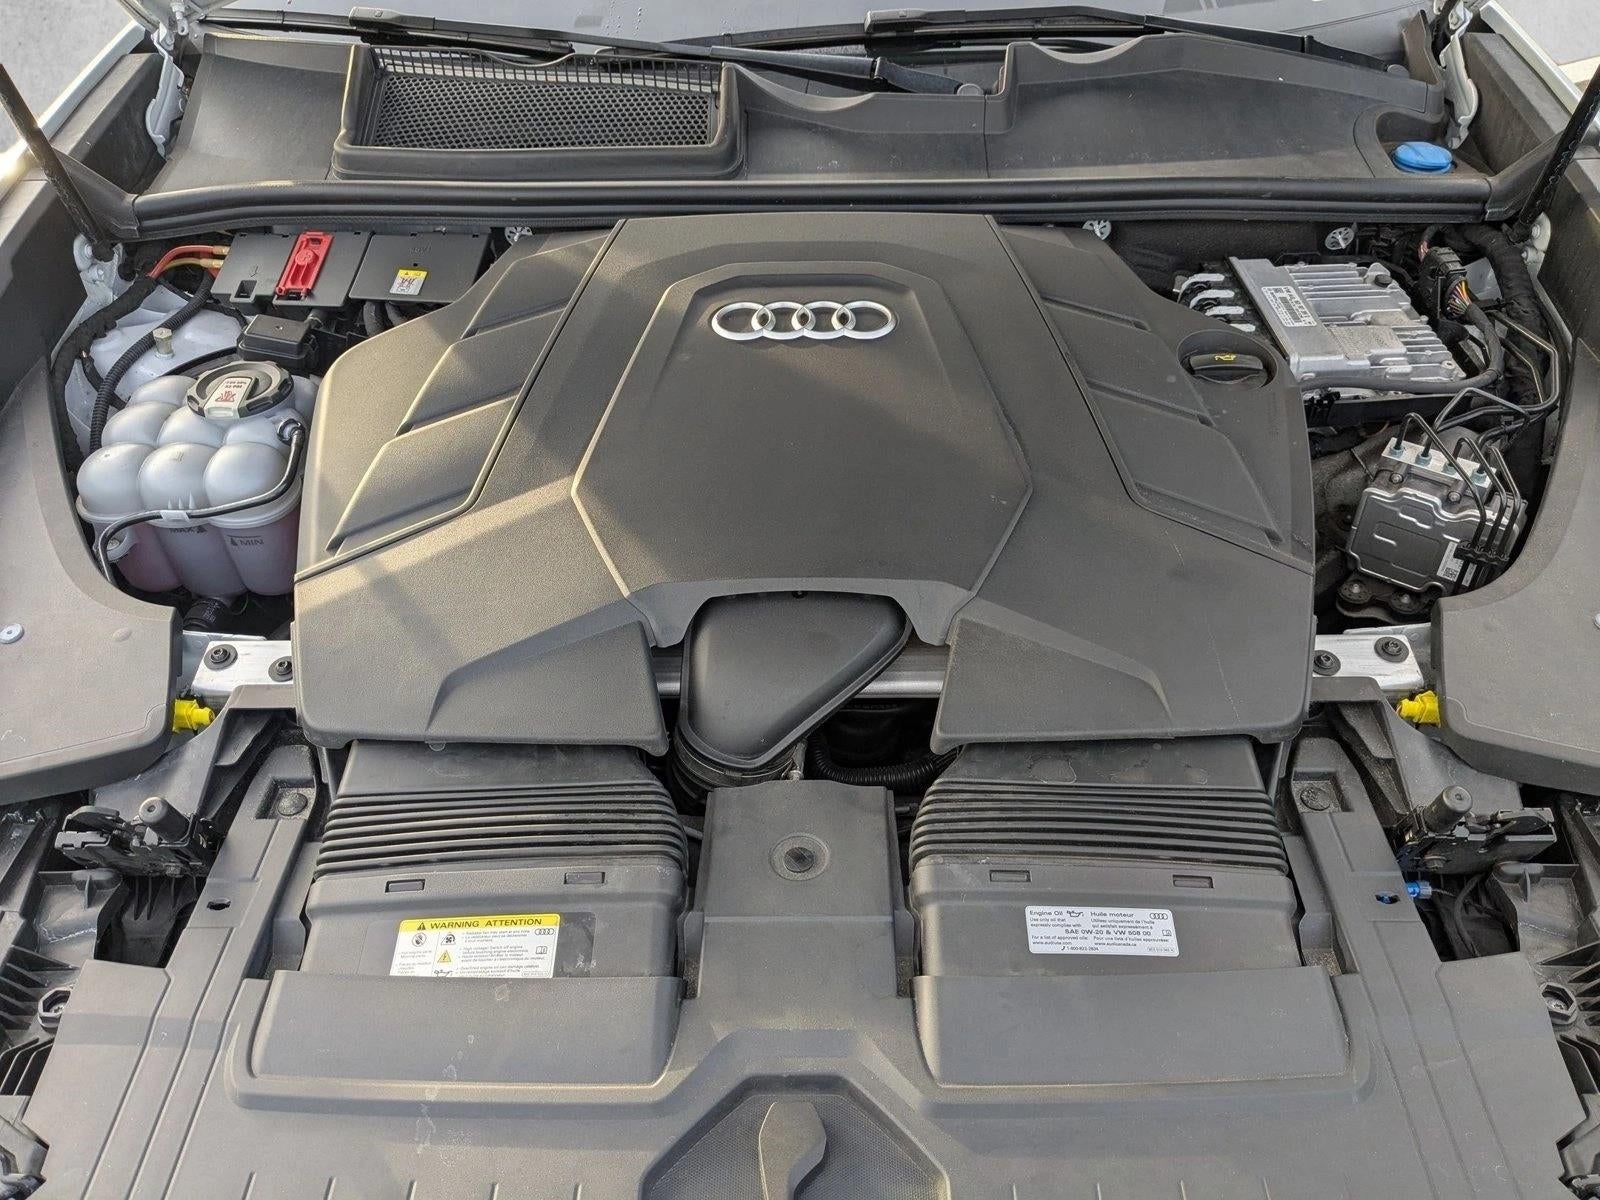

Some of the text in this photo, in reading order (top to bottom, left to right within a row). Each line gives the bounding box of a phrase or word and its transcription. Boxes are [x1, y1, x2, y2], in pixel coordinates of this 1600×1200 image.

[240, 537, 264, 546] MIN
[430, 918, 542, 930] WARNING ATTENTION
